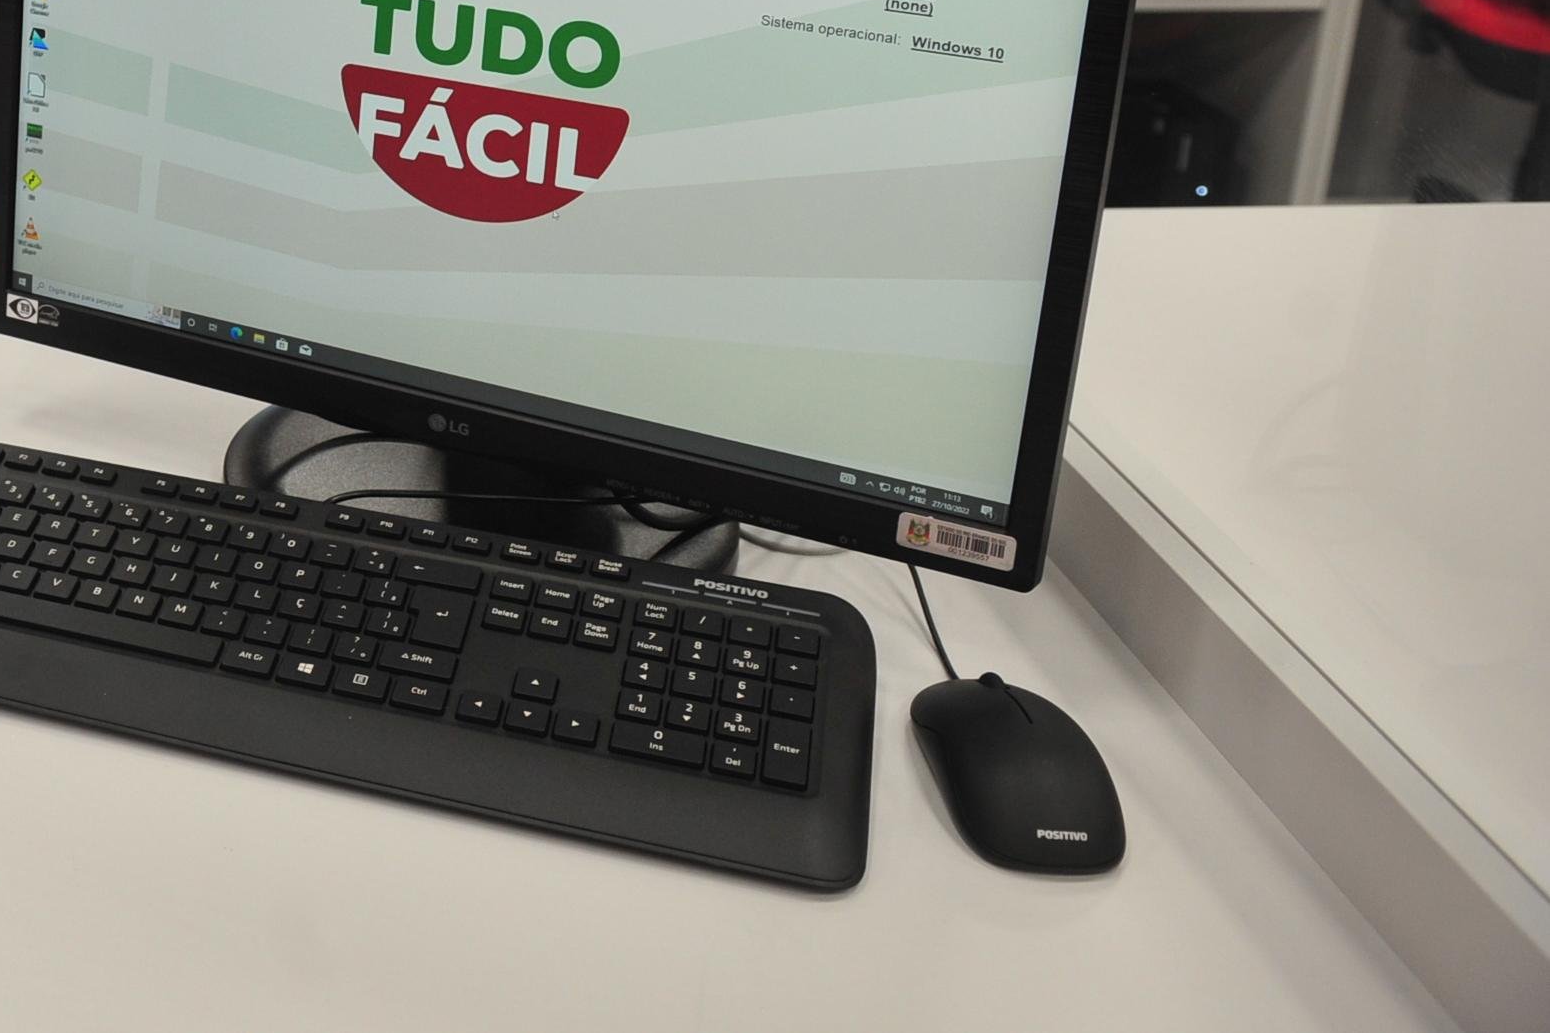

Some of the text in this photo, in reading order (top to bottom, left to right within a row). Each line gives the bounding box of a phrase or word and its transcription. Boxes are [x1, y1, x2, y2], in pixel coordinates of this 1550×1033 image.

[761, 15, 1004, 60] Sistema operacional: Windows 10
[358, 87, 600, 192] FÁCIL
[450, 420, 469, 436] LG
[911, 486, 926, 495] POR
[127, 564, 136, 572] H
[12, 570, 21, 578] C
[171, 573, 177, 581] J
[54, 578, 62, 586] V
[210, 581, 219, 589] K
[500, 580, 524, 589] Insert
[93, 587, 102, 595] B
[693, 578, 769, 599] POSITIVO
[254, 590, 260, 598] L
[545, 589, 570, 598] Home
[594, 594, 614, 603] Page
[297, 599, 304, 608] Ç
[175, 604, 186, 613] M
[492, 608, 519, 618] Delete
[645, 603, 667, 615] Num
[542, 618, 558, 626] End
[584, 623, 606, 634] Page
[584, 629, 608, 638] Down
[637, 642, 663, 651] Home
[694, 641, 702, 649] 8
[411, 654, 432, 663] Shift
[744, 650, 751, 658] 9
[733, 659, 744, 667] Pg
[689, 672, 696, 680] 5
[738, 681, 746, 689] 6
[411, 687, 427, 695] Ctrl
[629, 704, 646, 713] End
[686, 704, 693, 712] 2
[735, 713, 742, 722] 3
[724, 722, 751, 733] Pg Dn
[654, 731, 663, 739] 0
[650, 742, 663, 750] Ins
[774, 743, 799, 753] Enter
[726, 757, 741, 766] Del
[1036, 829, 1088, 842] POSITIVO
